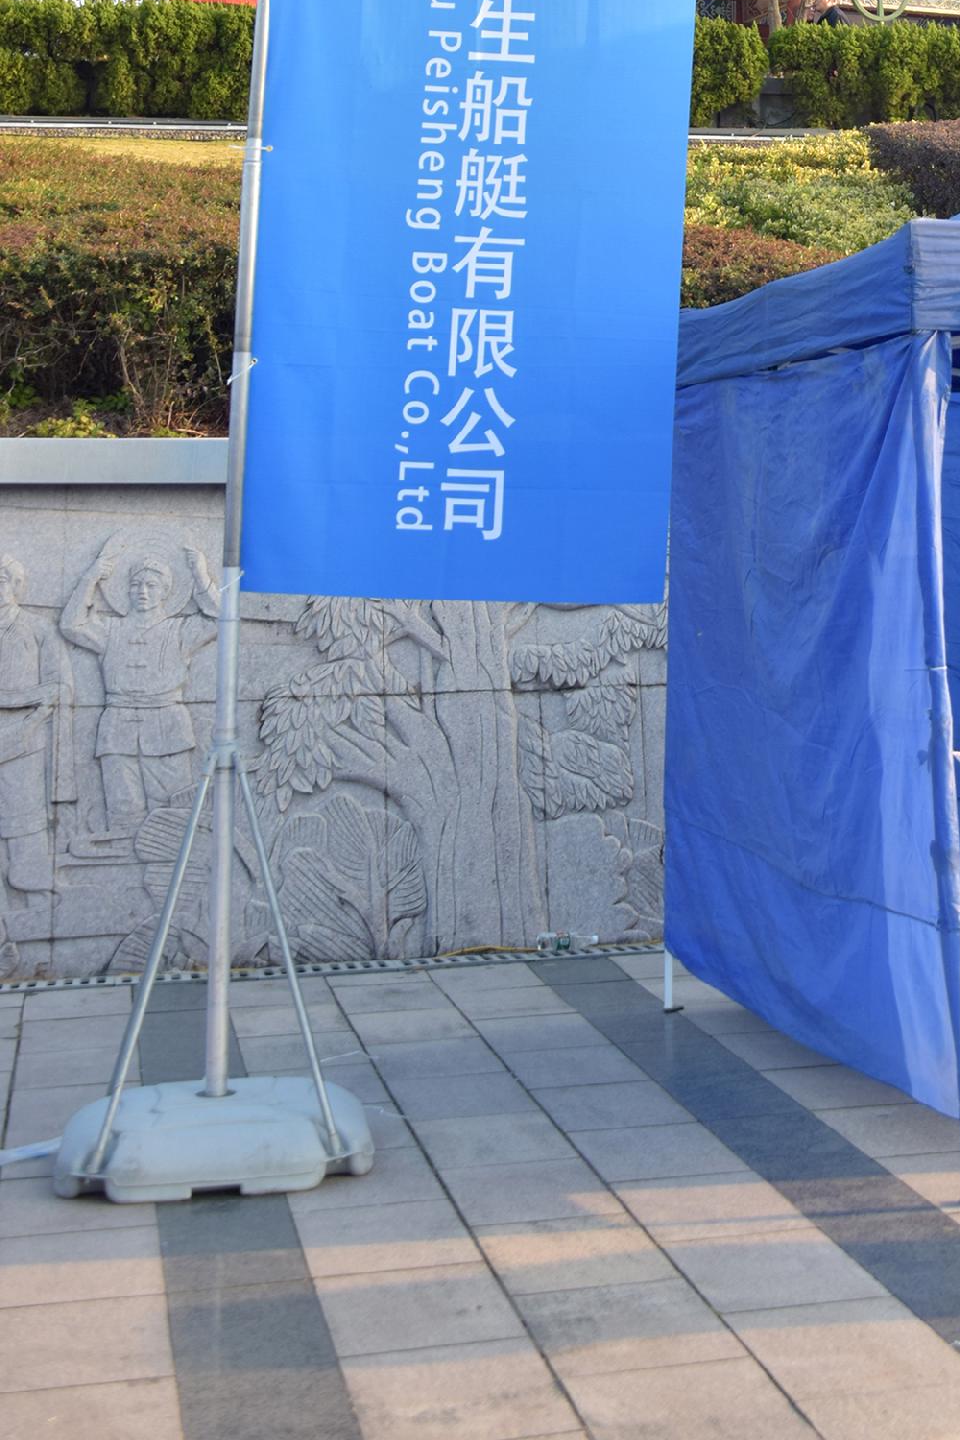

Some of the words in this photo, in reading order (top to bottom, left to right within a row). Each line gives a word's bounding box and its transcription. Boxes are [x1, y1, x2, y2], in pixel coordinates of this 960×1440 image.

[405, 29, 463, 231] Peisheng
[406, 251, 448, 352] Boat
[394, 369, 441, 531] Co.,Ltd
